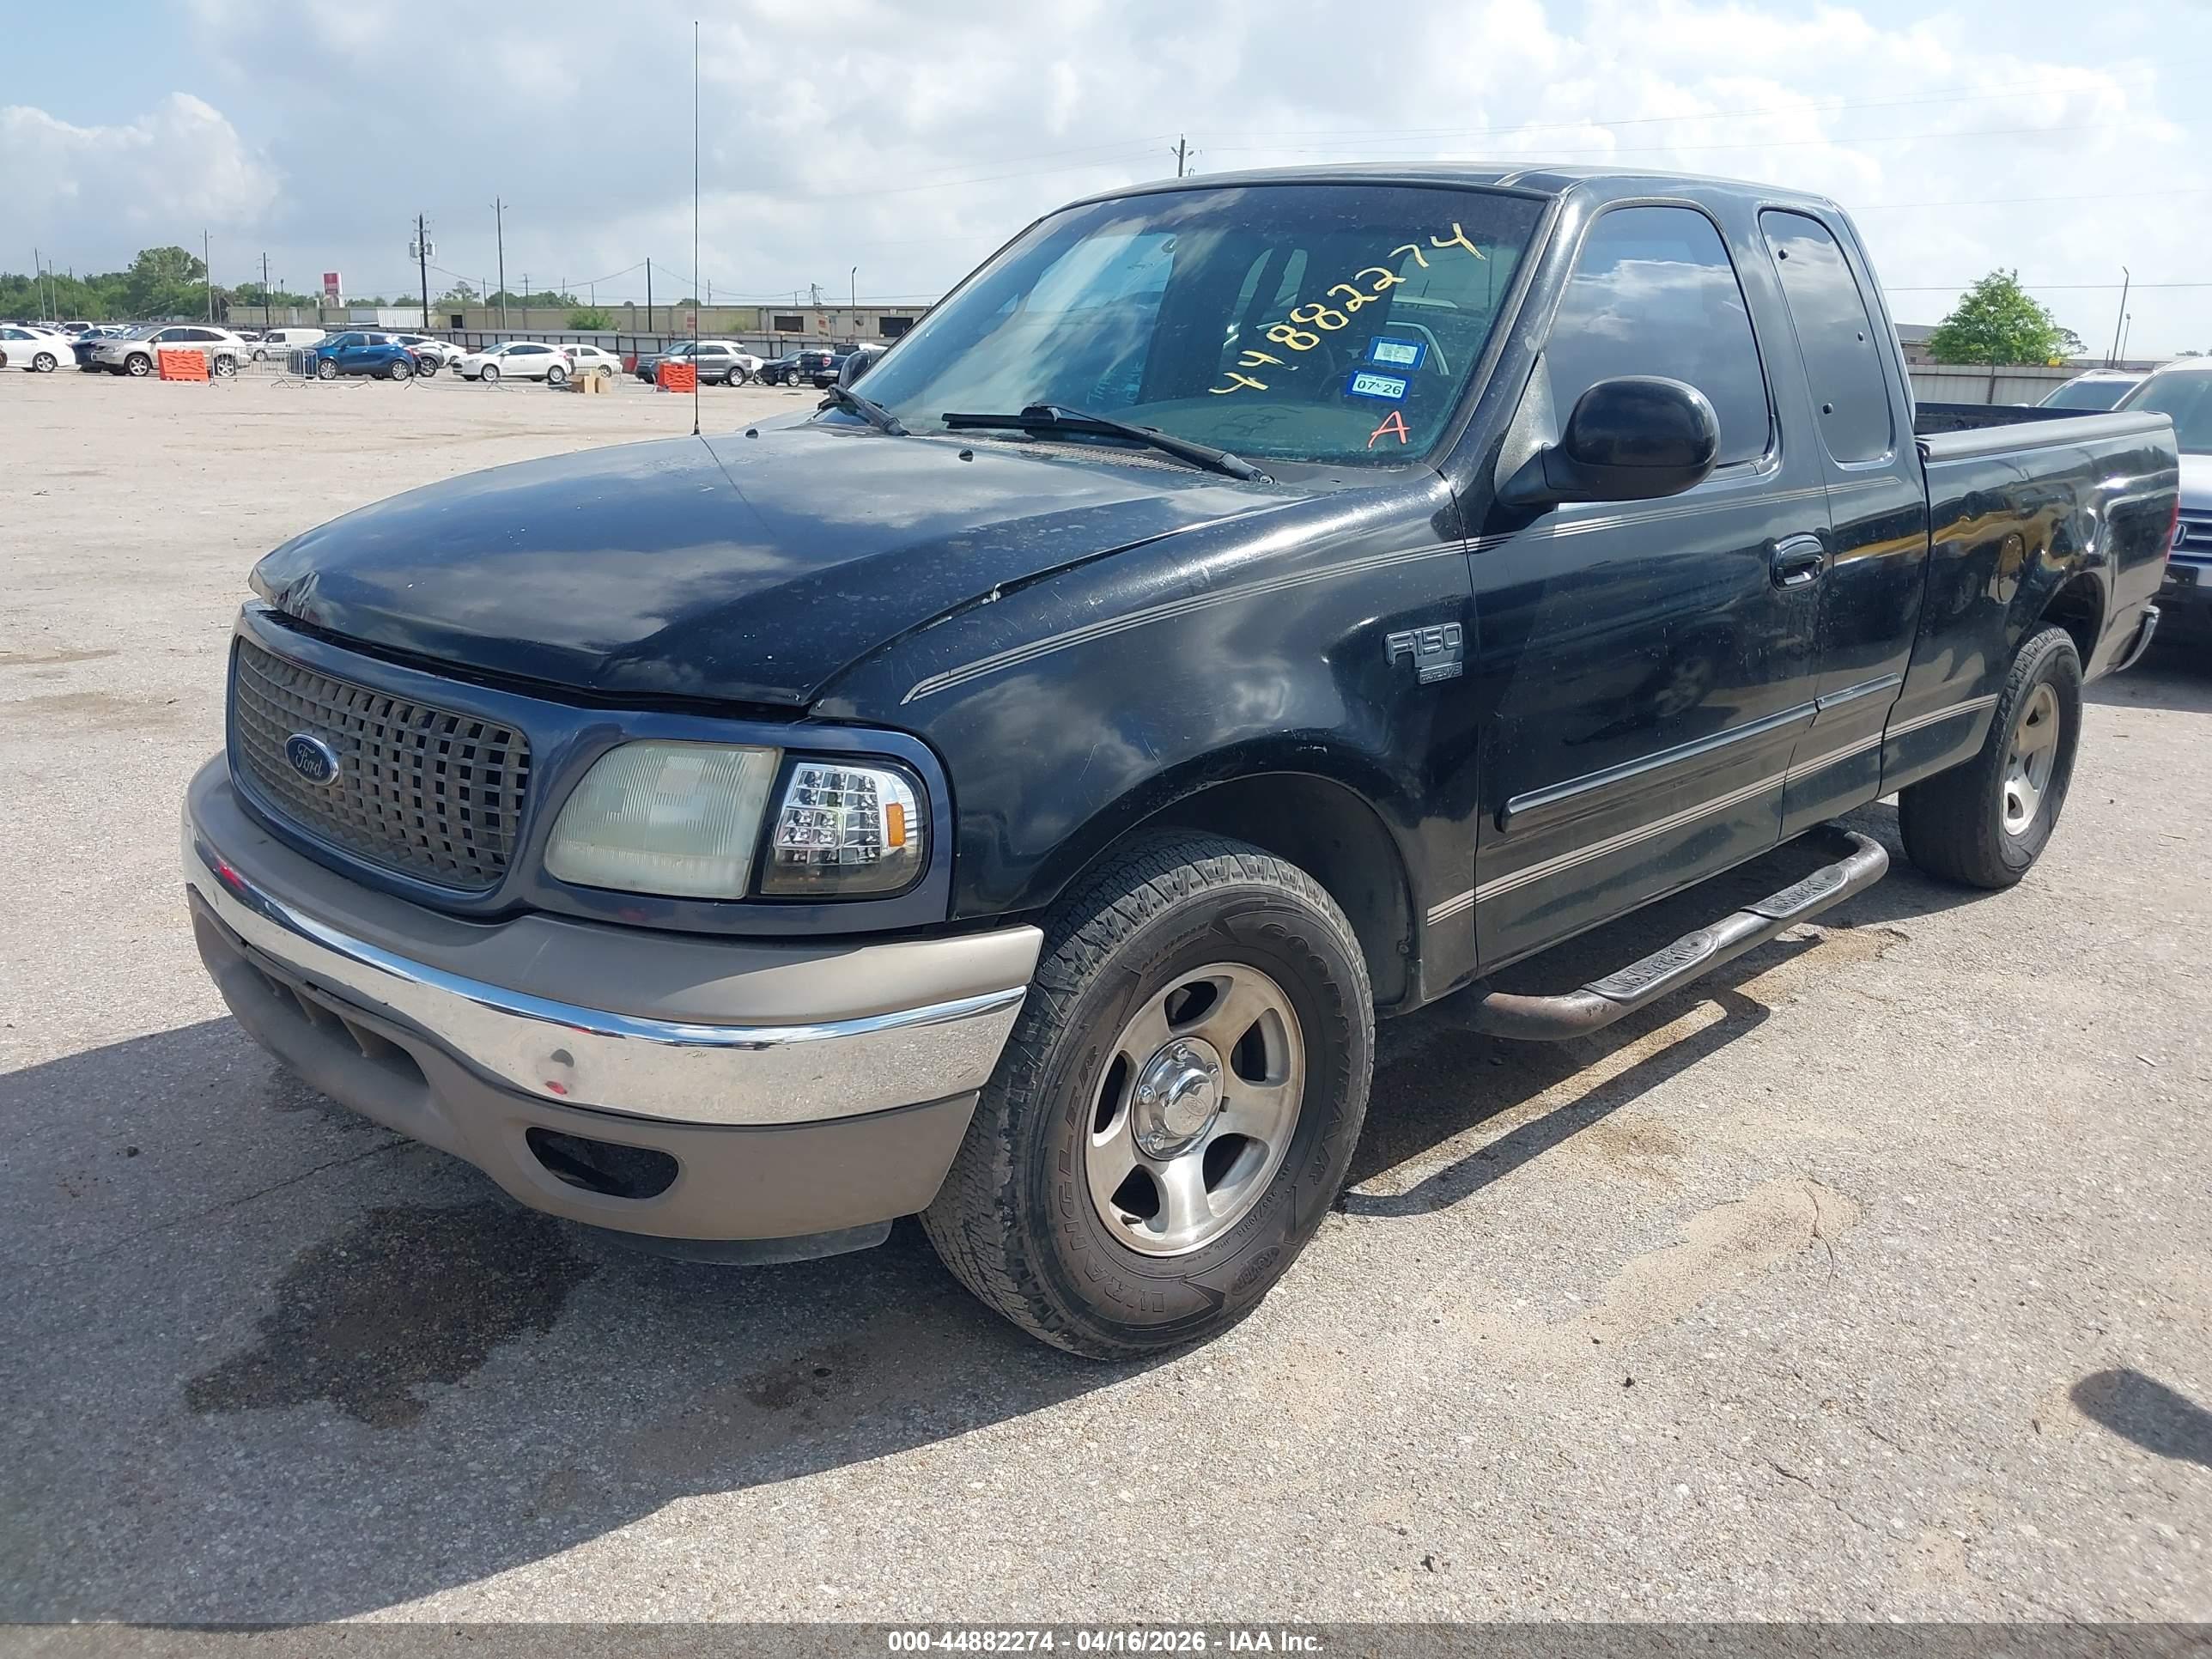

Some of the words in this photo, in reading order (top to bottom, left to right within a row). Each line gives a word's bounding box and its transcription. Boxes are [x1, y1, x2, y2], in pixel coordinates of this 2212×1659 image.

[1207, 222, 1486, 395] 44882274
[1357, 380, 1376, 391] 07
[1382, 383, 1402, 396] 26
[1367, 410, 1411, 449] A
[295, 742, 324, 777] Ford
[1057, 1043, 1165, 1313] WRANGLER
